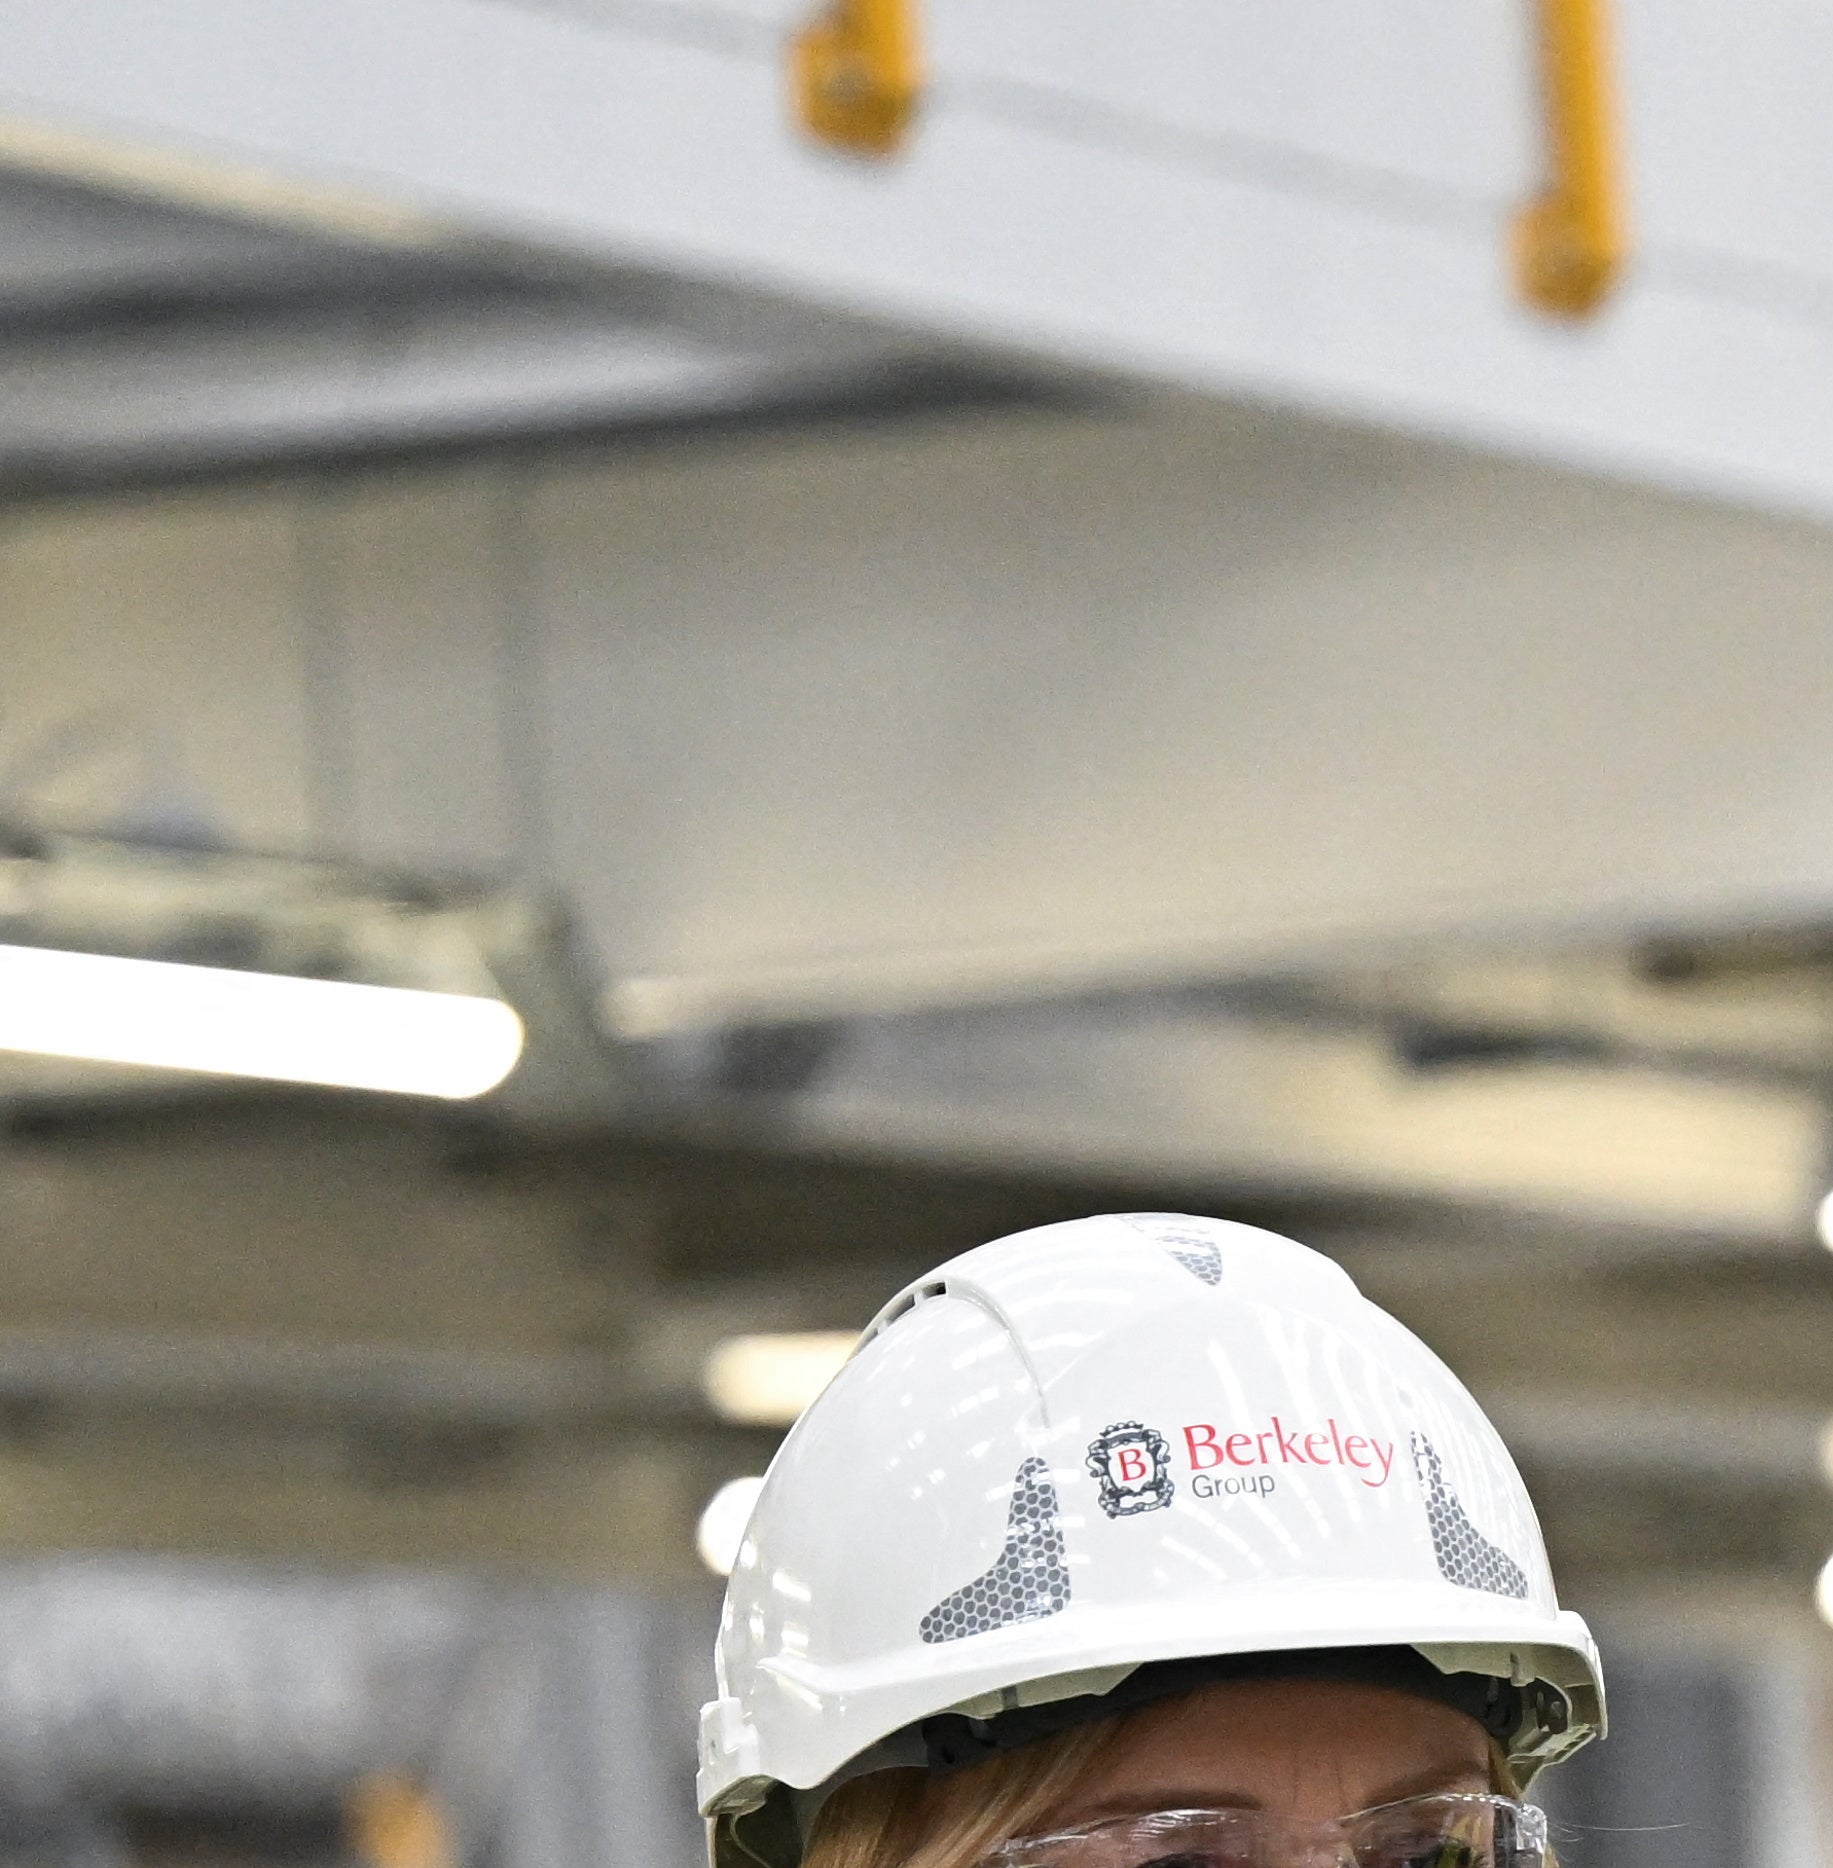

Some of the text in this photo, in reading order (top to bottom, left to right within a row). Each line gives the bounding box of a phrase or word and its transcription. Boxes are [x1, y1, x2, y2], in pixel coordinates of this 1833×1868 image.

[1117, 1447, 1147, 1482] B
[1182, 1416, 1394, 1488] Berkeley
[1191, 1473, 1276, 1499] Group
